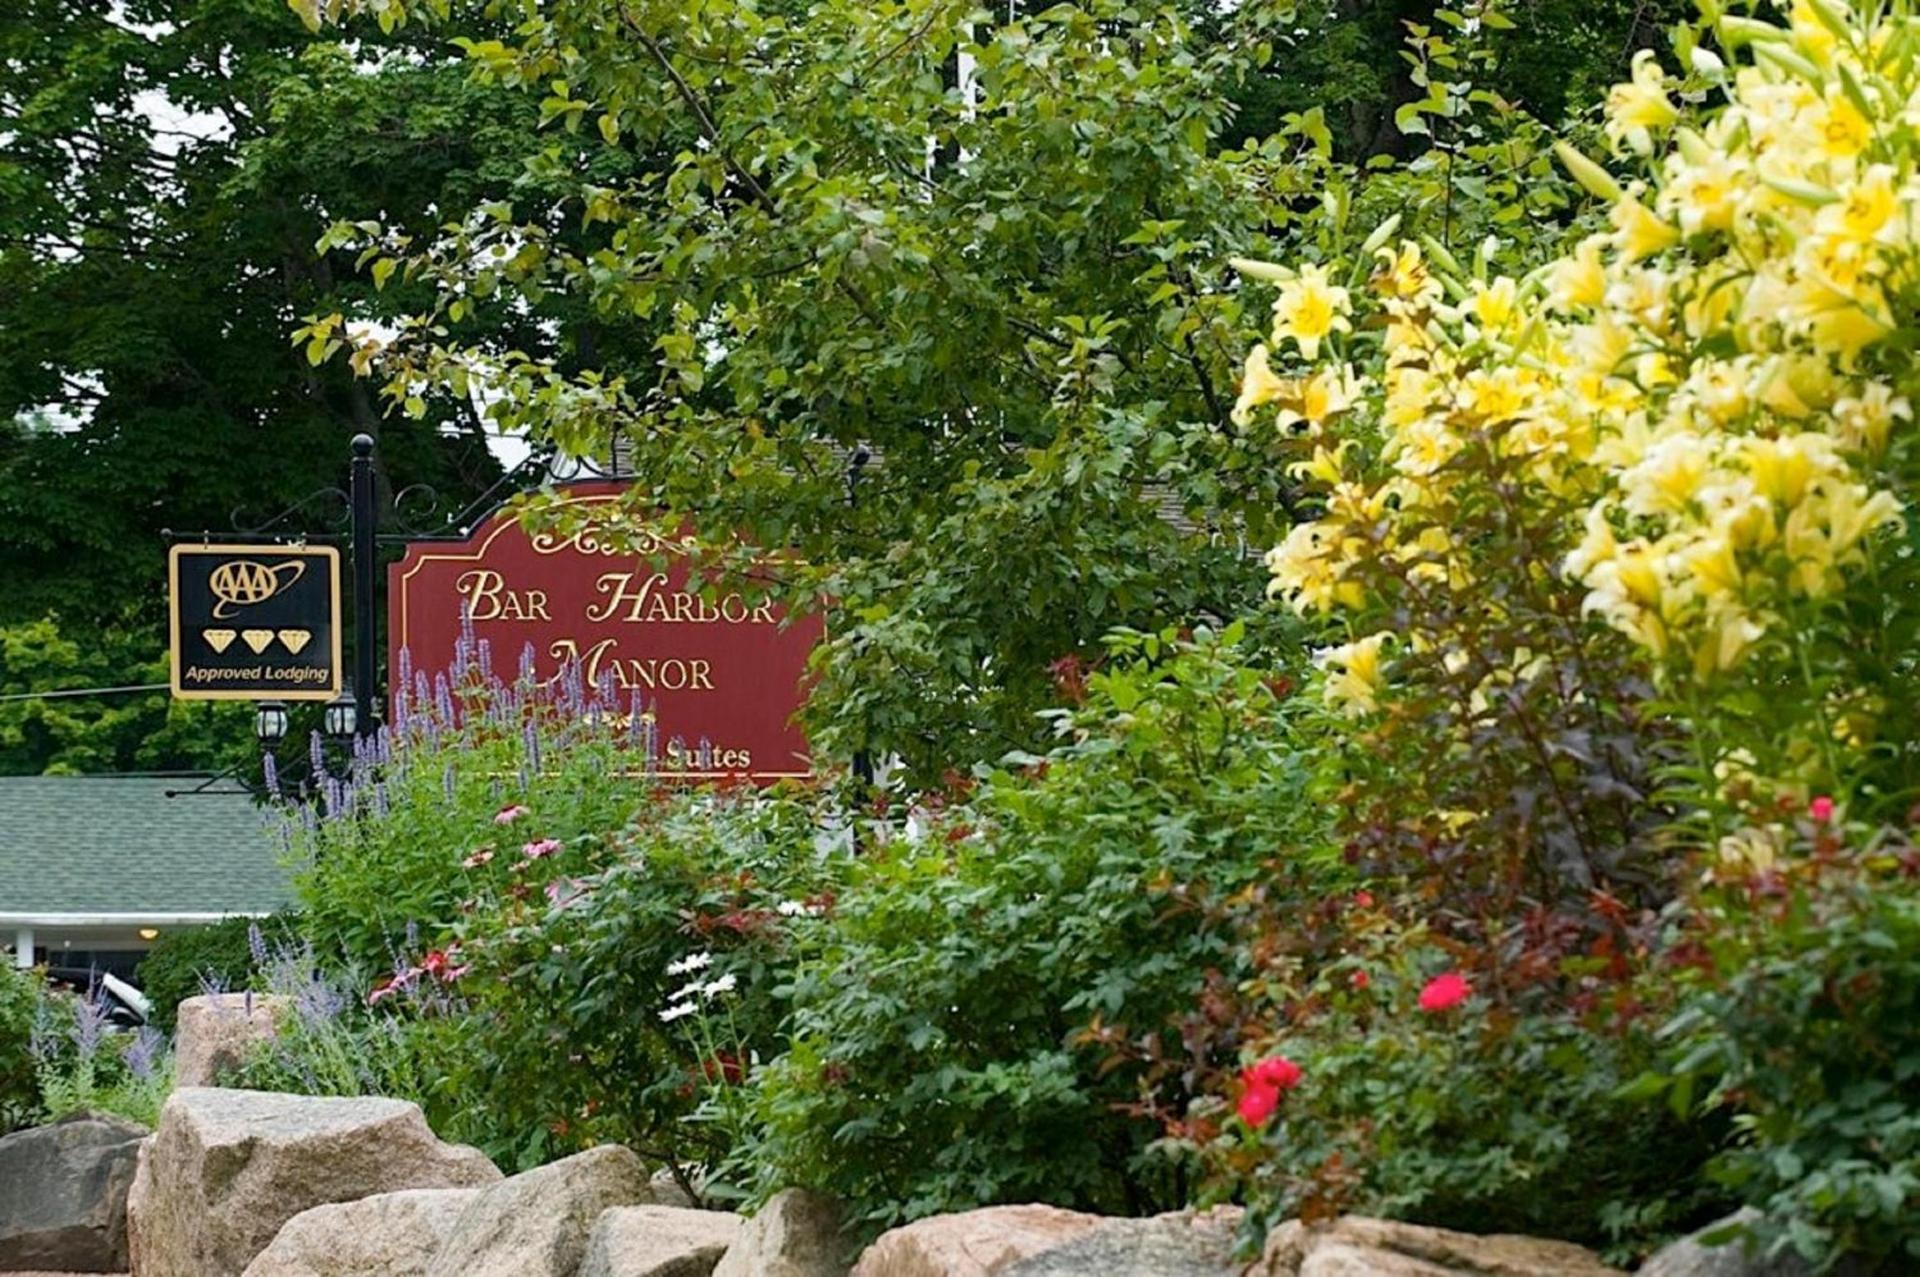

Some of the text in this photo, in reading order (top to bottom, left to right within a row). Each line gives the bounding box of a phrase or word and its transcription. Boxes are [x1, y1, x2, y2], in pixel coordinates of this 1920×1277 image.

[217, 562, 272, 602] AAA
[185, 666, 328, 683] Approved Lodging
[667, 739, 751, 768] Sutes
